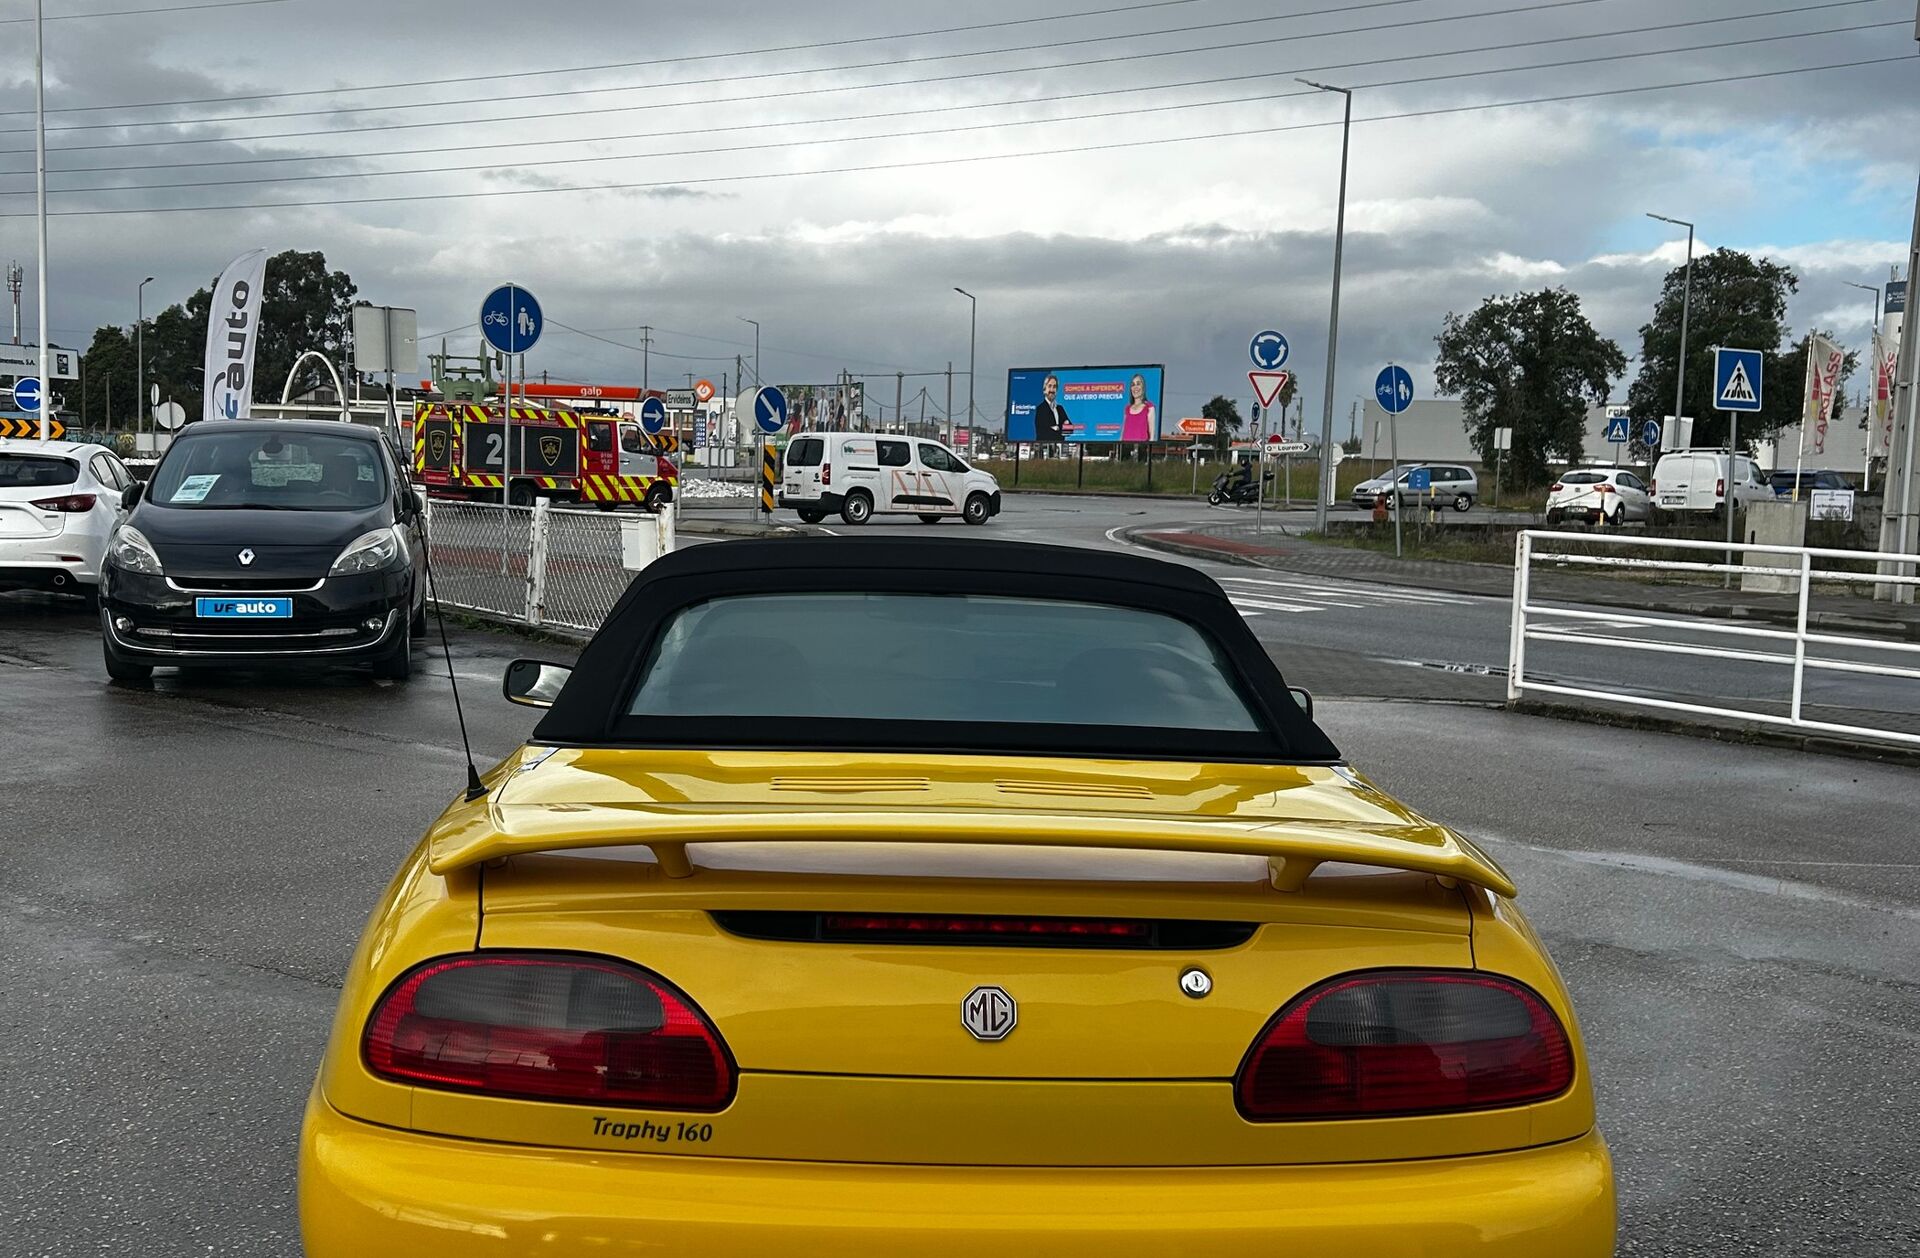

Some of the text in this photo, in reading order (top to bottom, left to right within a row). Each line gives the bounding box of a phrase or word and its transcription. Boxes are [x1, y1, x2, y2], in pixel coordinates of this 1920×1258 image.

[580, 386, 603, 396] galp
[1814, 351, 1842, 455] CARGLASS
[485, 433, 503, 465] 2
[967, 990, 1011, 1034] MG
[592, 1116, 713, 1142] Trophy 160
